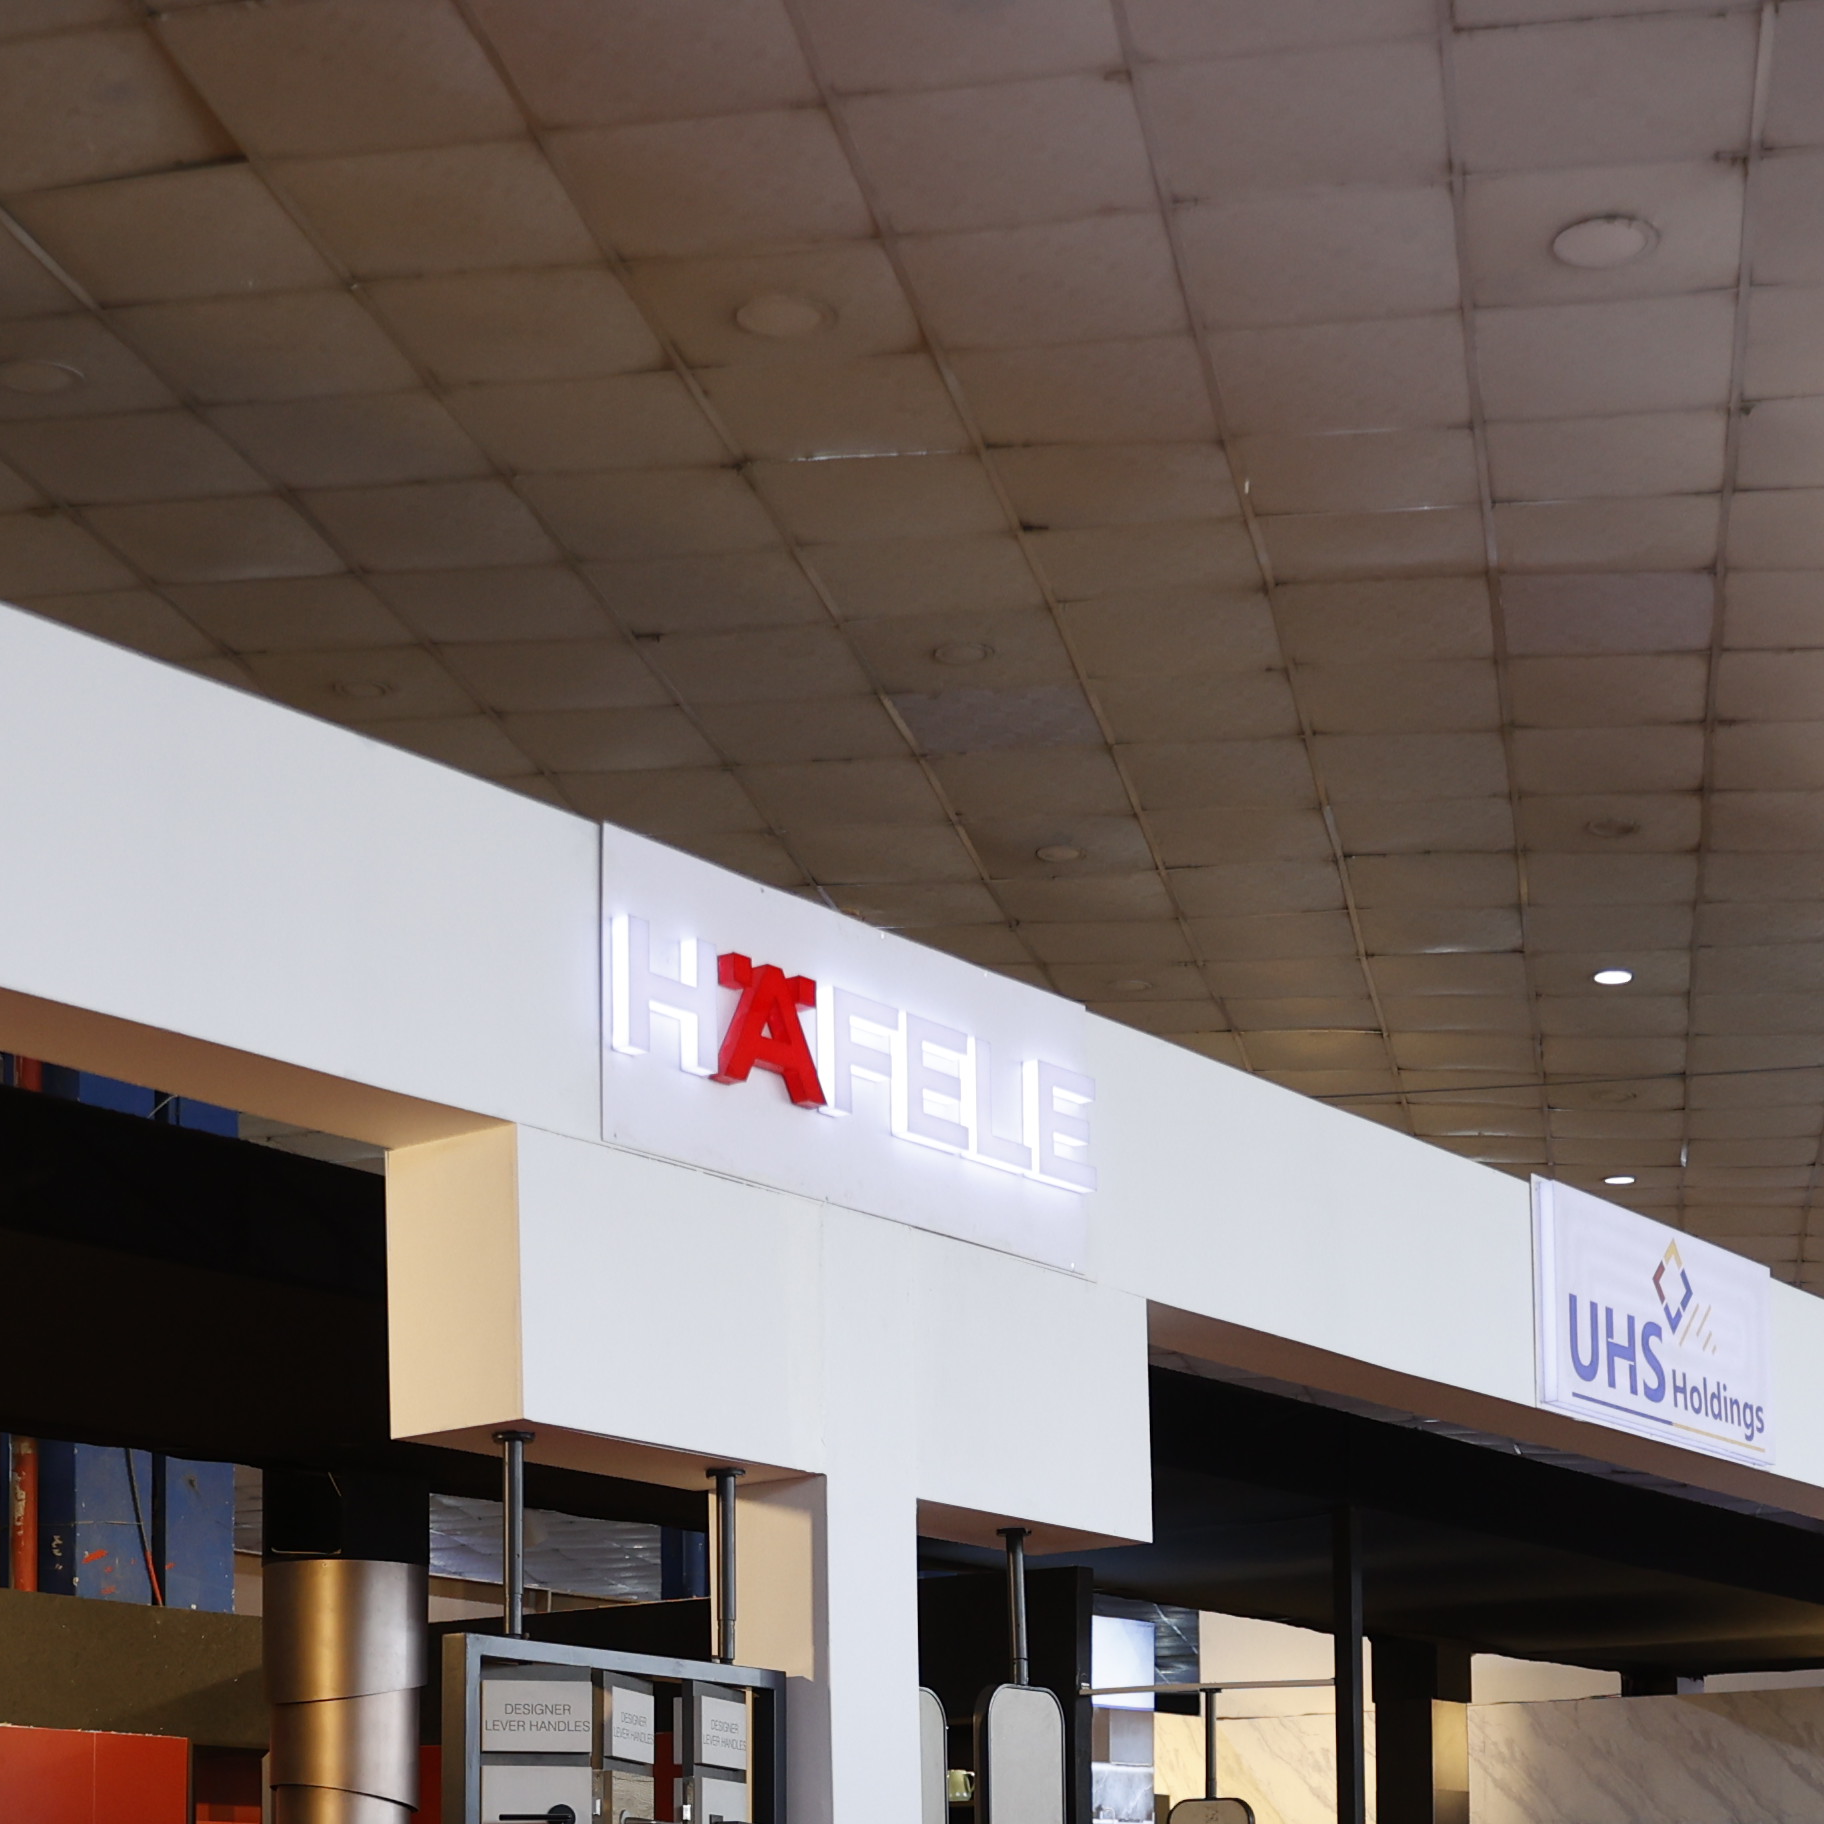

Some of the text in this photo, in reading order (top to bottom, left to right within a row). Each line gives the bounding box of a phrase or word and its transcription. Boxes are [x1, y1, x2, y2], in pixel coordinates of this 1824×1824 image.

[611, 914, 1097, 1193] HÄFELE
[1568, 1293, 1666, 1403] UHS
[1672, 1369, 1764, 1441] Holdings
[504, 1703, 572, 1716] DESIGNER
[485, 1720, 591, 1733] LEVER HANDLES
[620, 1711, 648, 1728] DESIGNER
[710, 1718, 740, 1734] DESIGNER
